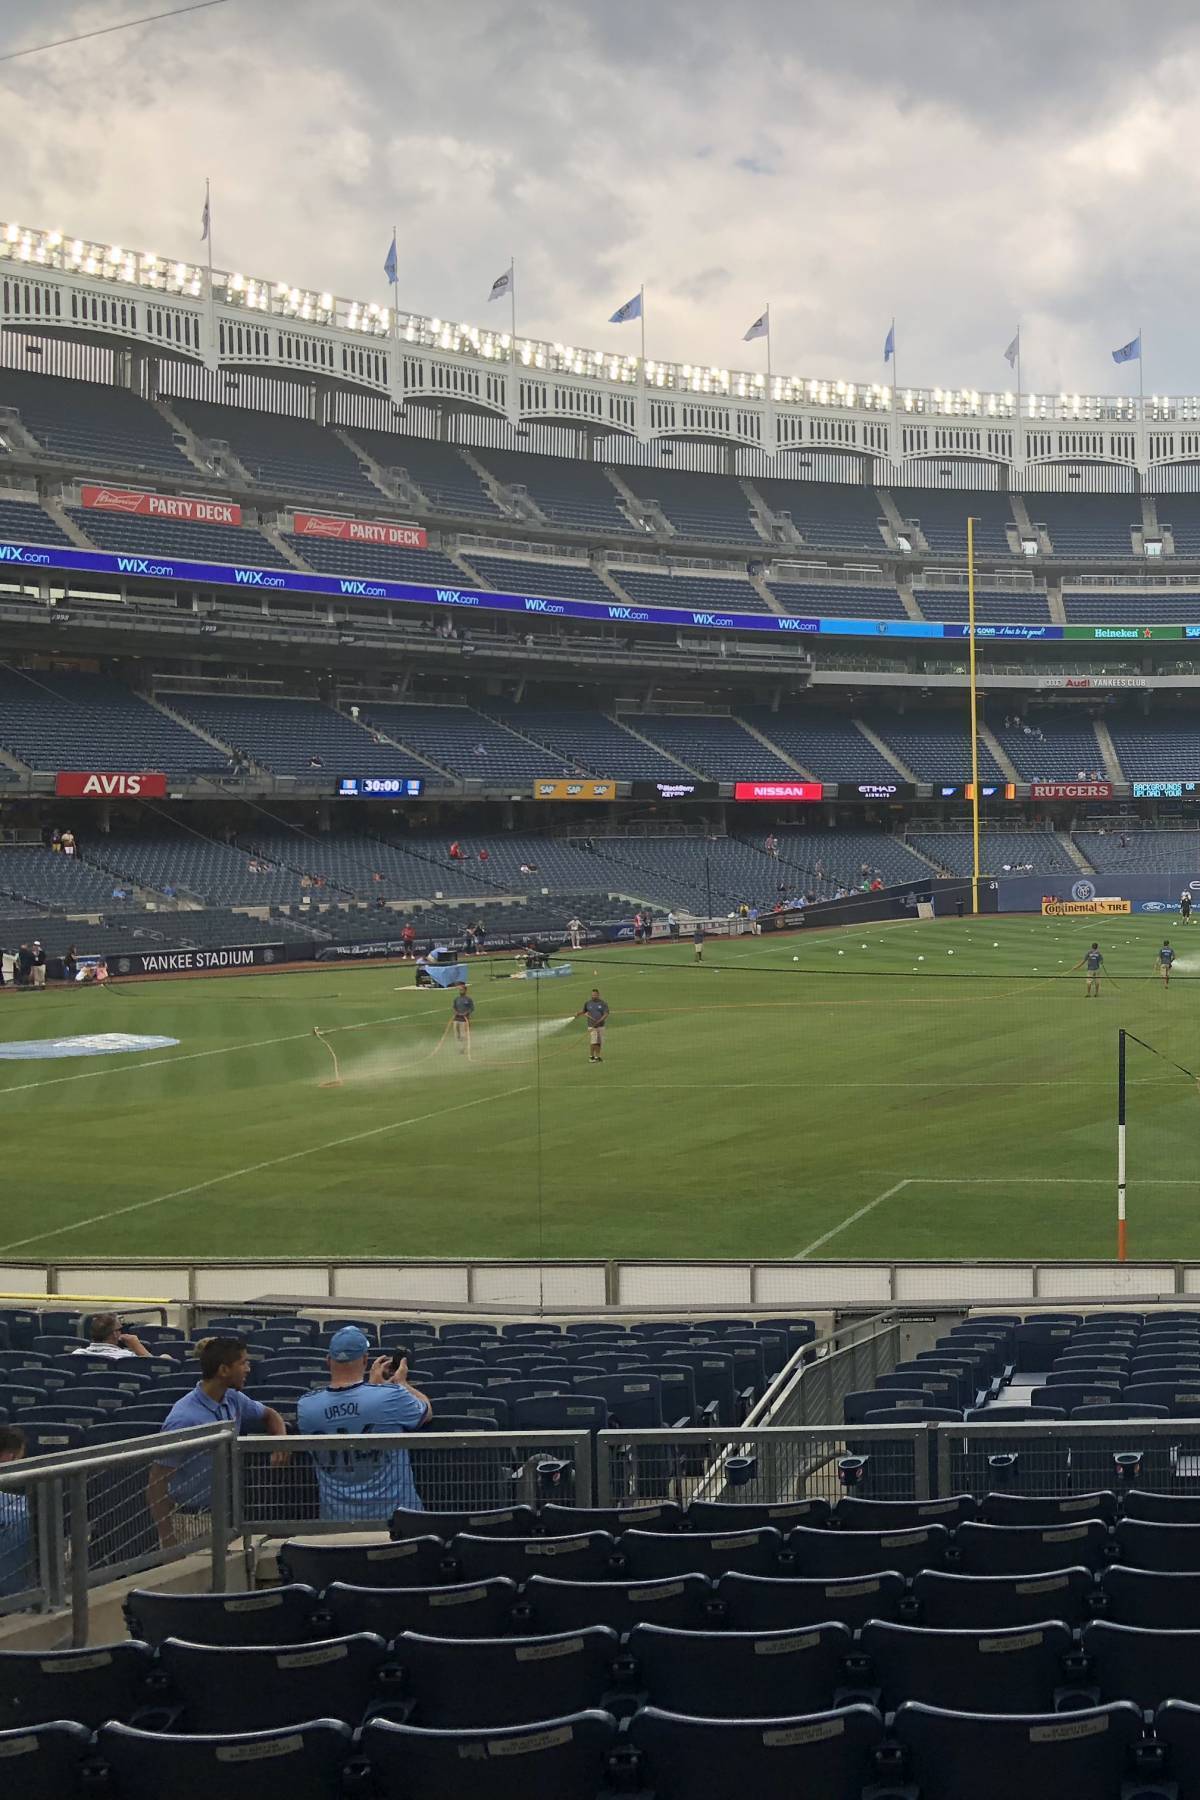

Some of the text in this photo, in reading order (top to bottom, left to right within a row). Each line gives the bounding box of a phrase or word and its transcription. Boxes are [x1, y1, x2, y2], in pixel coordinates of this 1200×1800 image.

[150, 498, 232, 522] PARTY DECK
[350, 523, 419, 545] PARTY DECK
[1095, 629, 1138, 638] Heineken
[1066, 679, 1146, 687] Audi YANKEES CLUB
[83, 775, 141, 794] AVIS
[364, 780, 400, 792] 30:00
[858, 785, 897, 793] ETIHAD
[540, 786, 554, 794] SAP
[567, 786, 581, 794] SAP
[593, 786, 607, 794] SAP
[754, 787, 803, 796] NISSAN
[1034, 786, 1109, 796] RUTGERS
[1044, 901, 1128, 914] Continental TIRE
[141, 950, 254, 971] YANKEE STADIUM
[324, 1402, 360, 1419] URSOL
